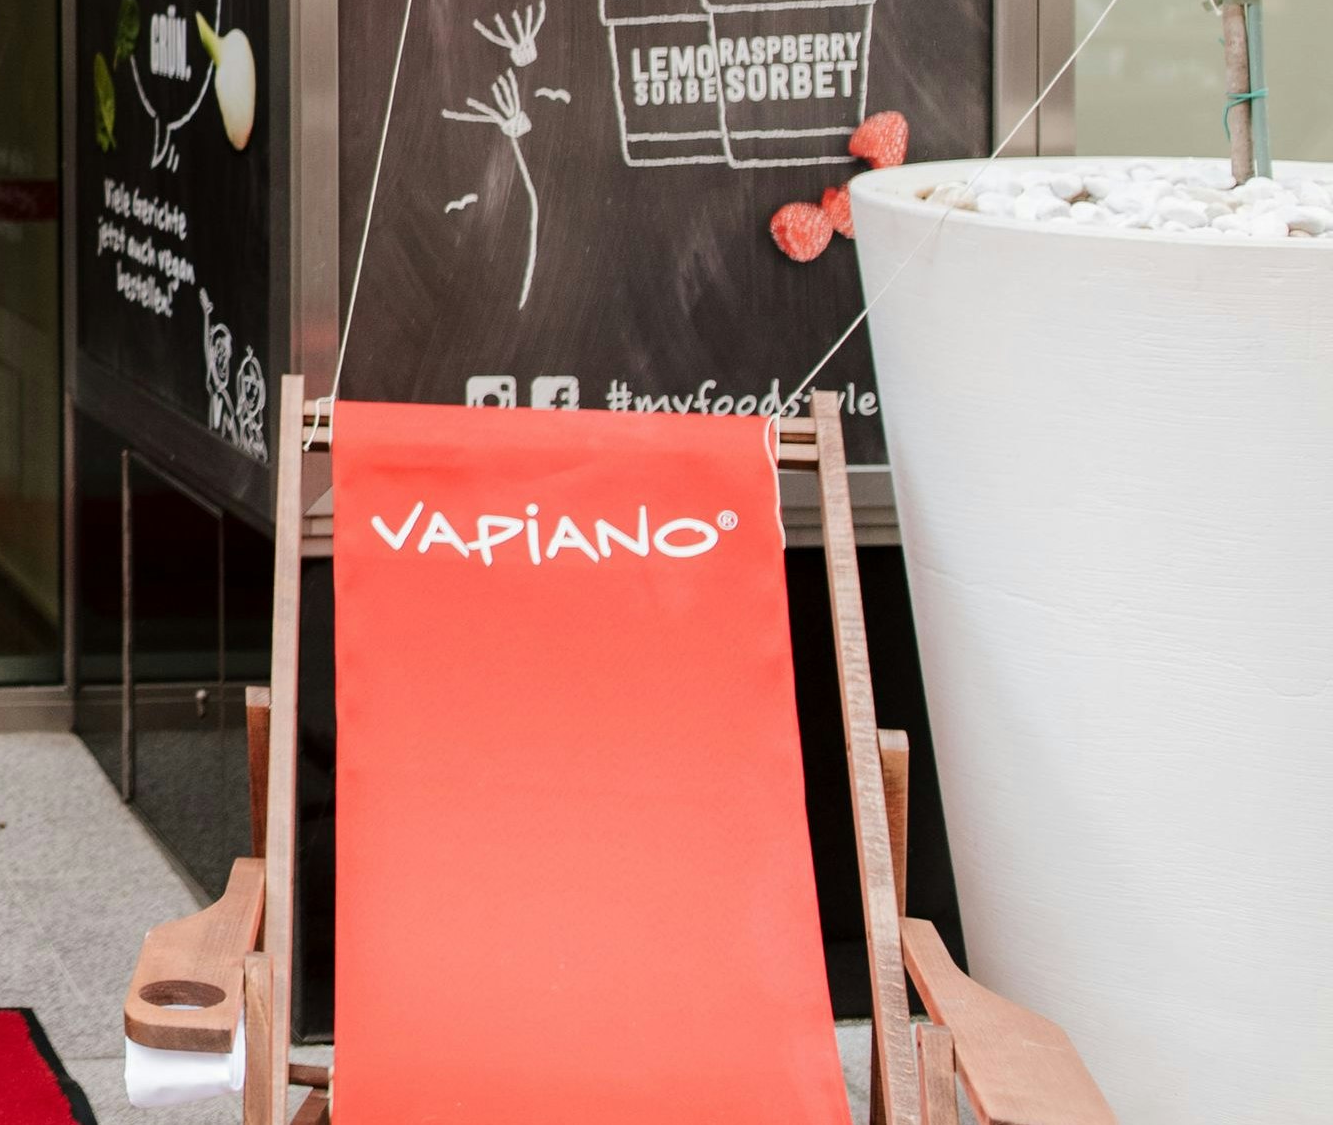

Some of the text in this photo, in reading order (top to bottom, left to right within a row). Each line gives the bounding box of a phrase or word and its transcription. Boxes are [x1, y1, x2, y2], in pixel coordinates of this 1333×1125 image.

[631, 44, 715, 82] LEMO
[719, 32, 861, 67] RASPBERRY
[634, 77, 718, 106] SORBE
[724, 60, 858, 103] SORBET
